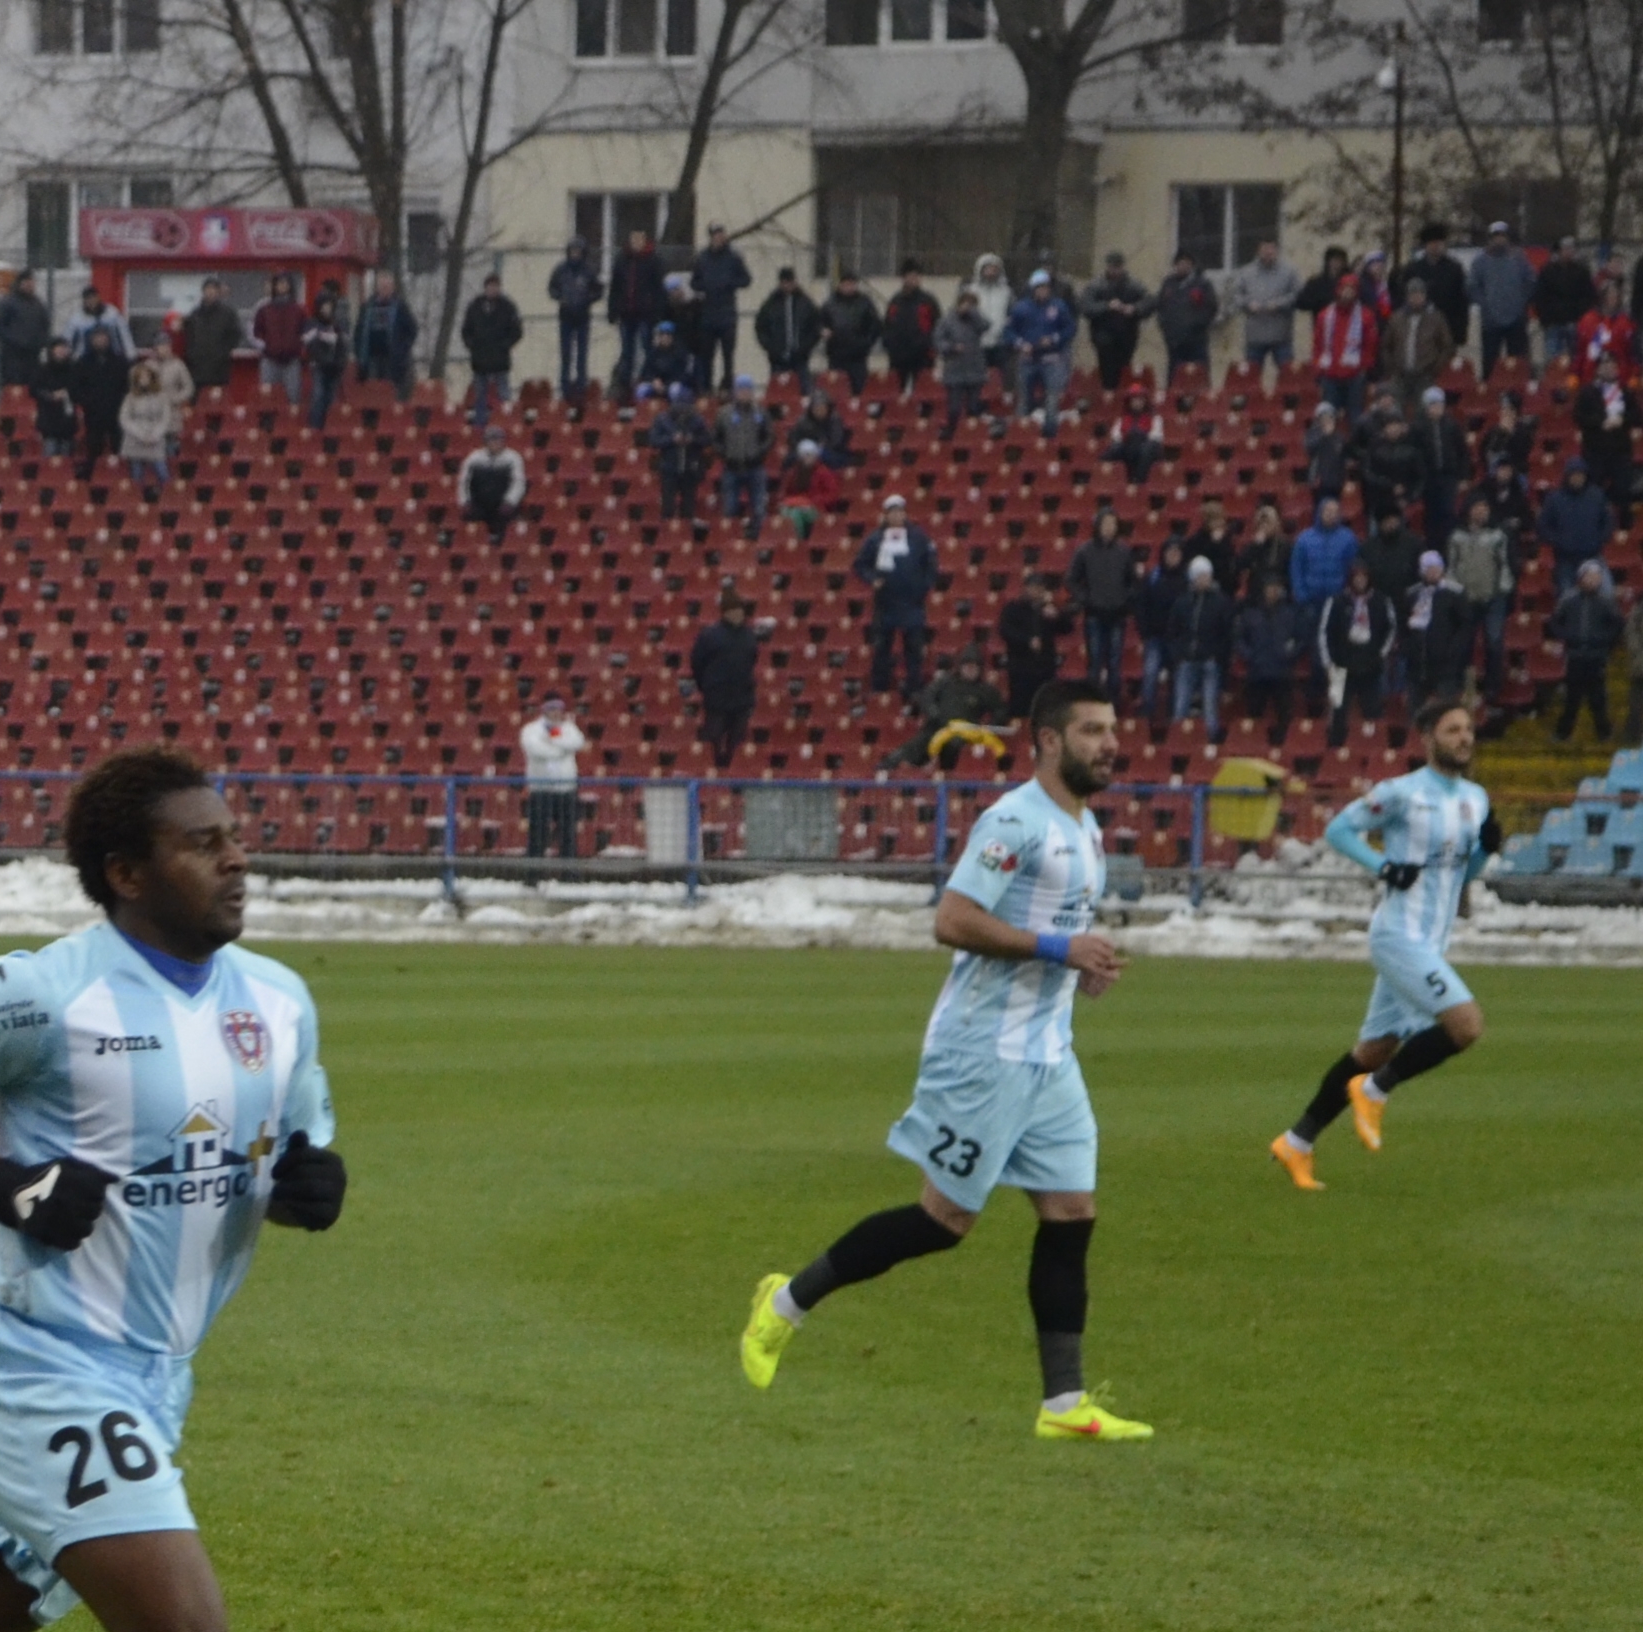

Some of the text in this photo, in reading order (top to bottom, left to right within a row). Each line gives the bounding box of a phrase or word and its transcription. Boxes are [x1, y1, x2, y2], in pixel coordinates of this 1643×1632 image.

[1426, 970, 1447, 998] 5
[928, 1125, 982, 1179] 23
[122, 1171, 250, 1208] energo
[47, 1410, 159, 1511] 26
